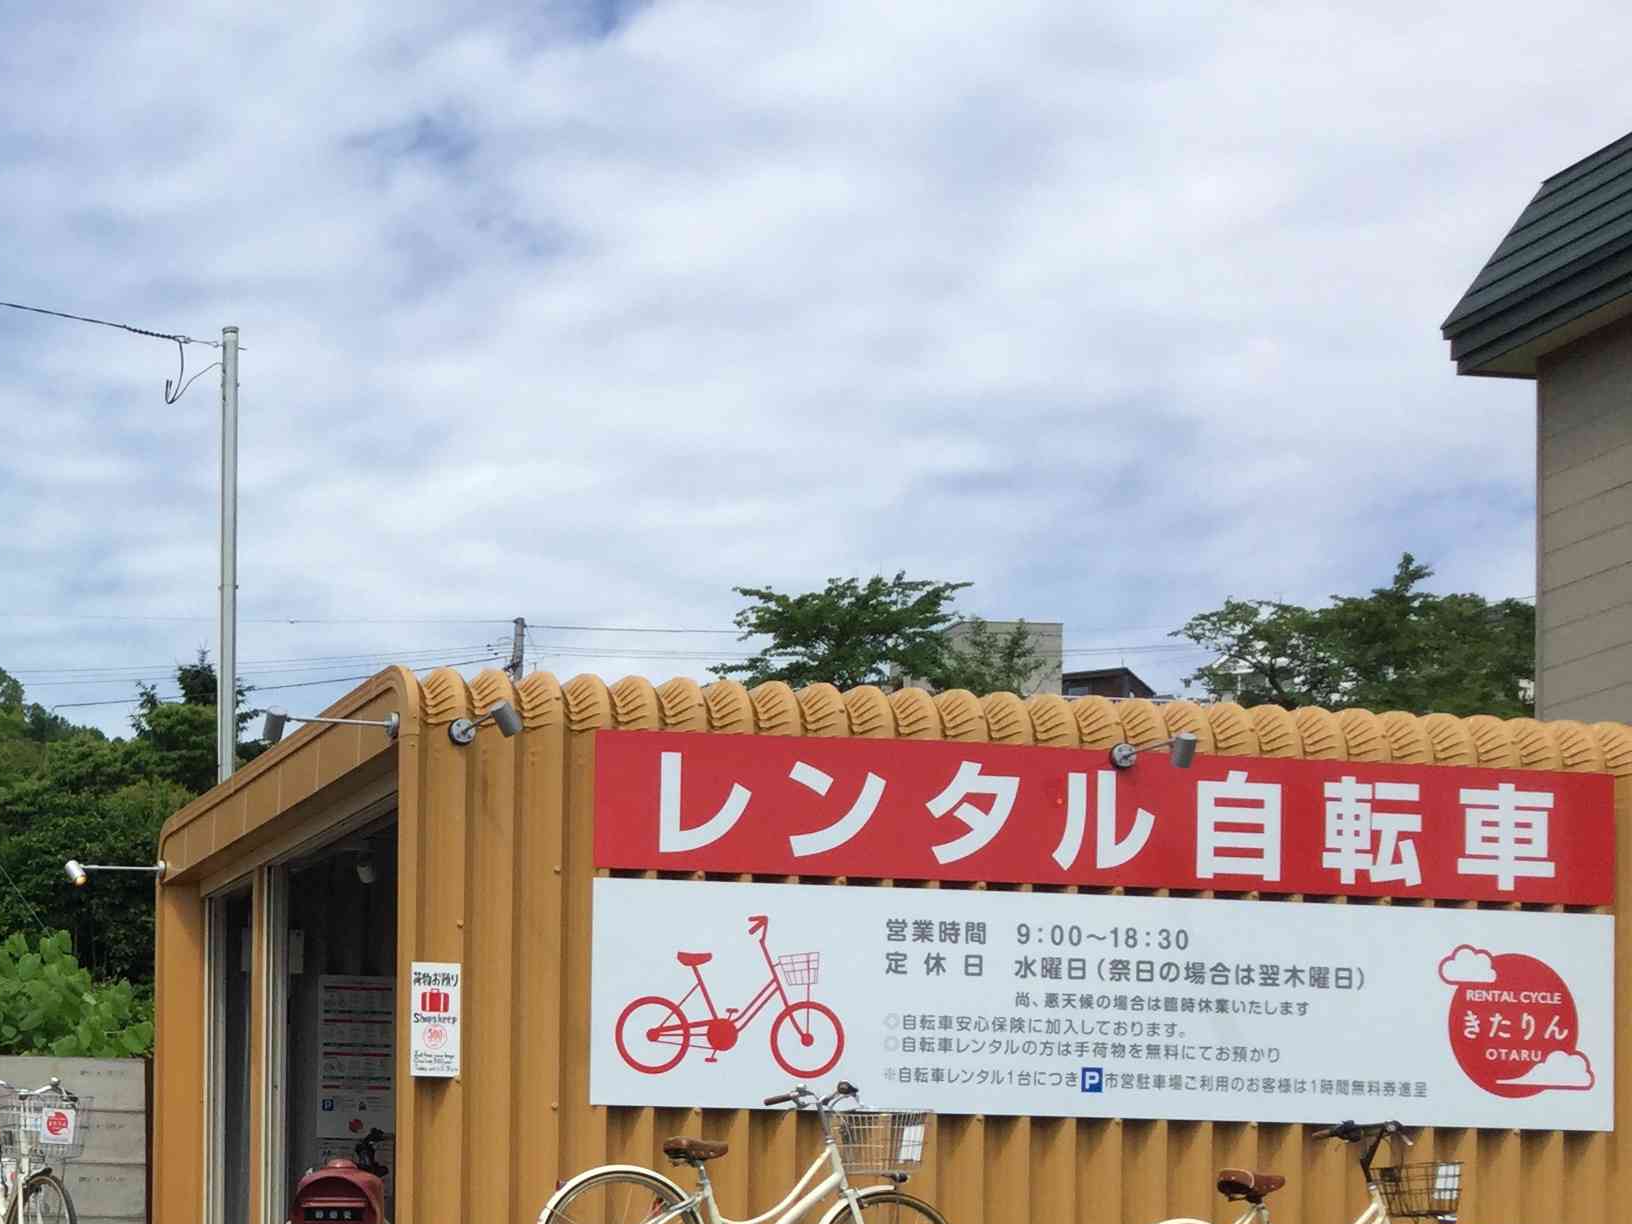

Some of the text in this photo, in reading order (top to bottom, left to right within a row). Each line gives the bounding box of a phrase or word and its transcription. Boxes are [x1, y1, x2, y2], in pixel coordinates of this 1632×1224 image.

[658, 751, 1556, 892] レンタル自転車
[886, 919, 987, 945] 営業時間
[1466, 989, 1562, 1004] RENTAL CYCLE
[1463, 1010, 1568, 1040] きたりん
[1485, 1048, 1542, 1062] OTARU
